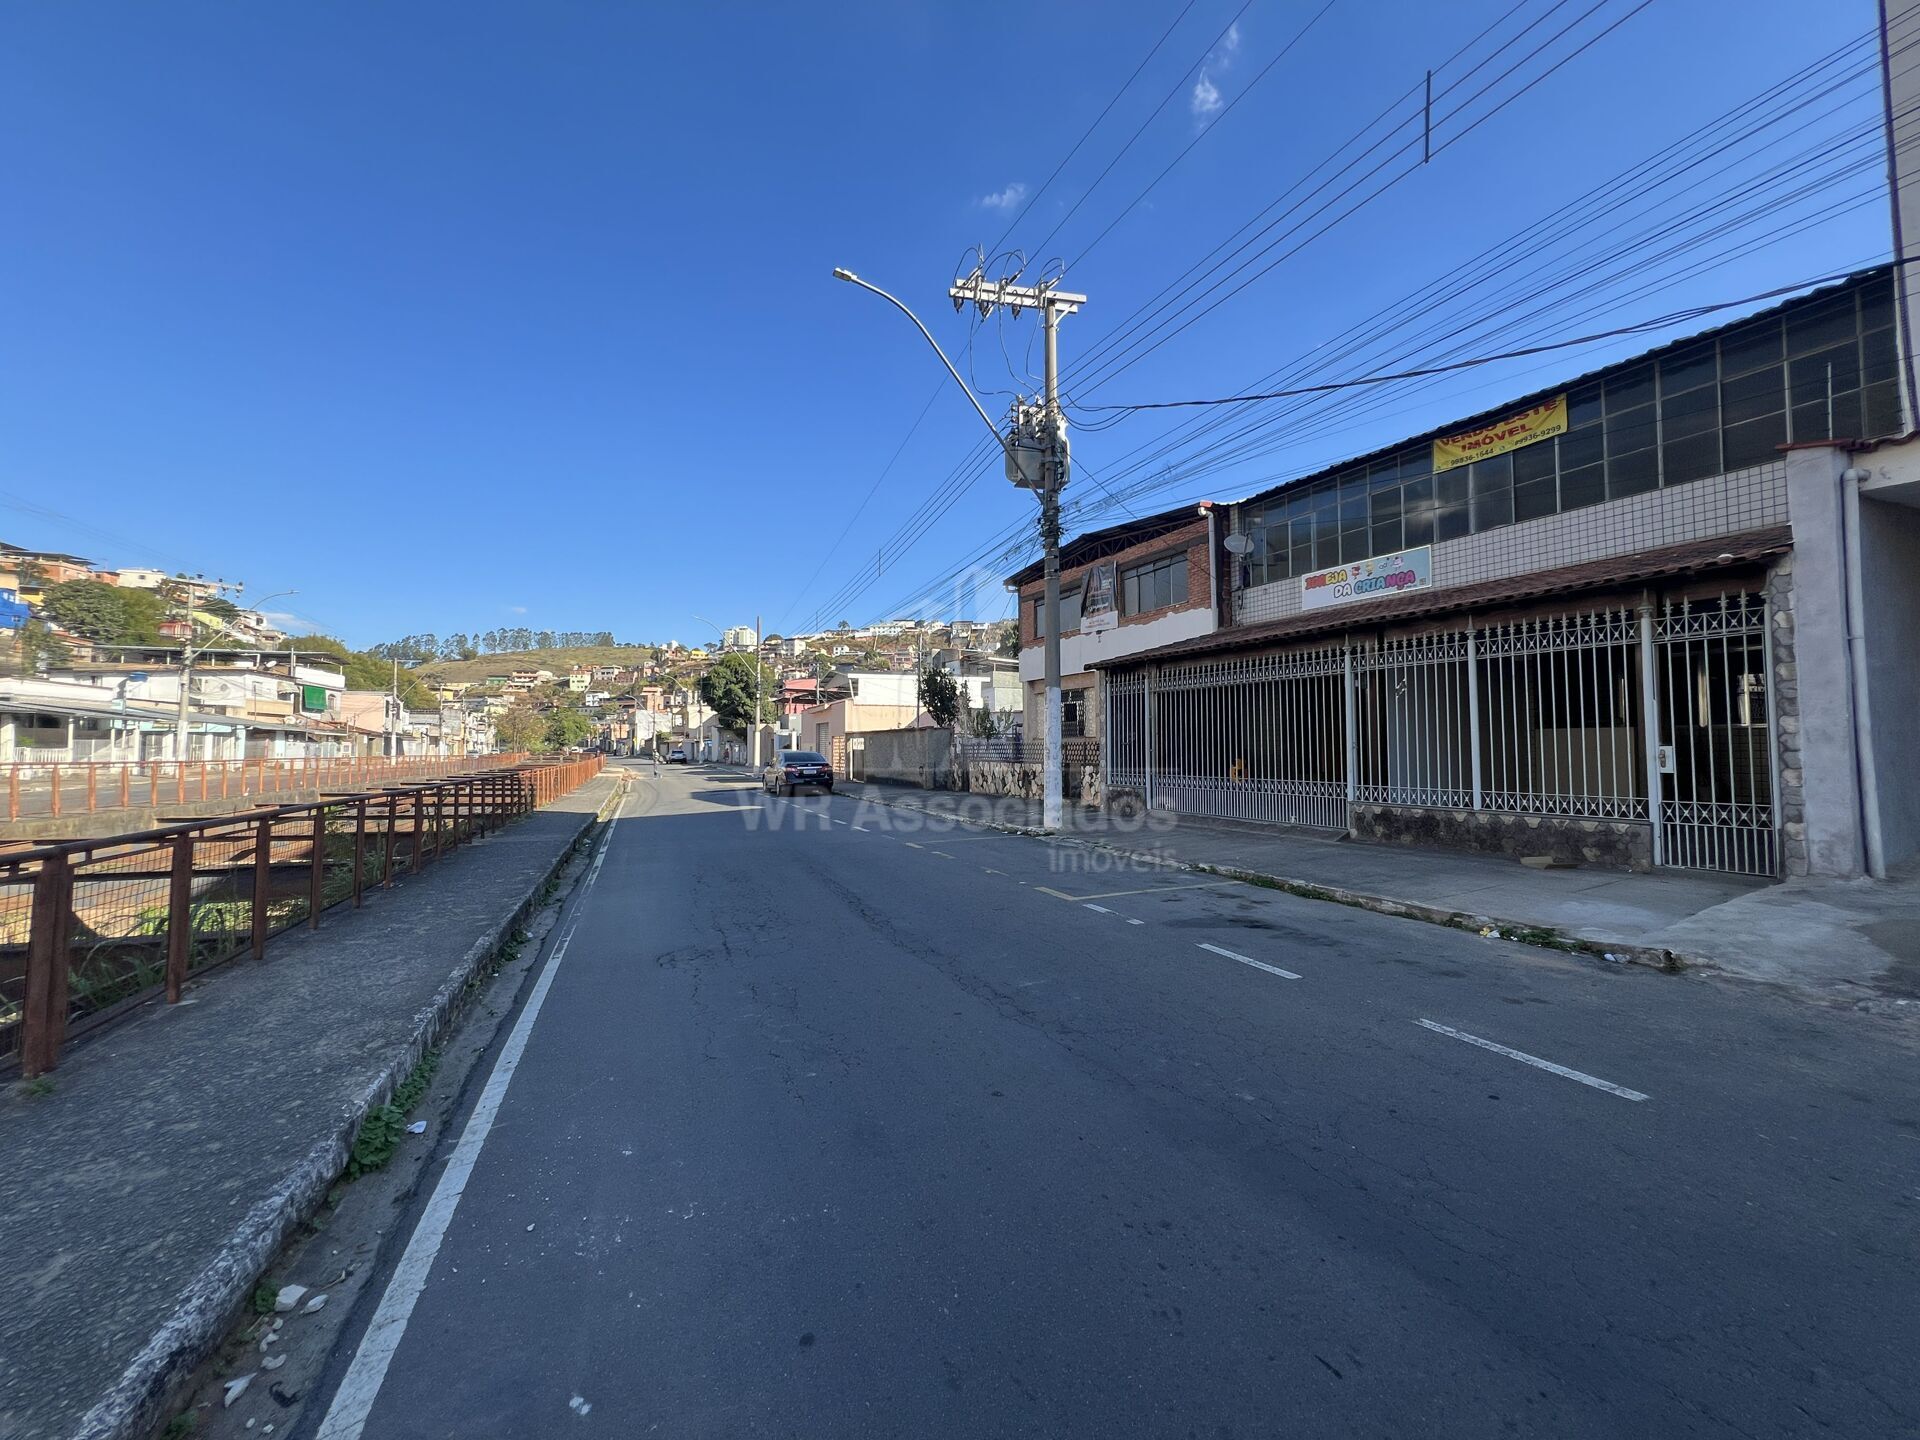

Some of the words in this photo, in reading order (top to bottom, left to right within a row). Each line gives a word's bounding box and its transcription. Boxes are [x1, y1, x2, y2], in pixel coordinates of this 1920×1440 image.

[1461, 424, 1533, 453] IMÓVEL
[1334, 583, 1352, 598] DA
[1354, 570, 1416, 594] CRIANÇA
